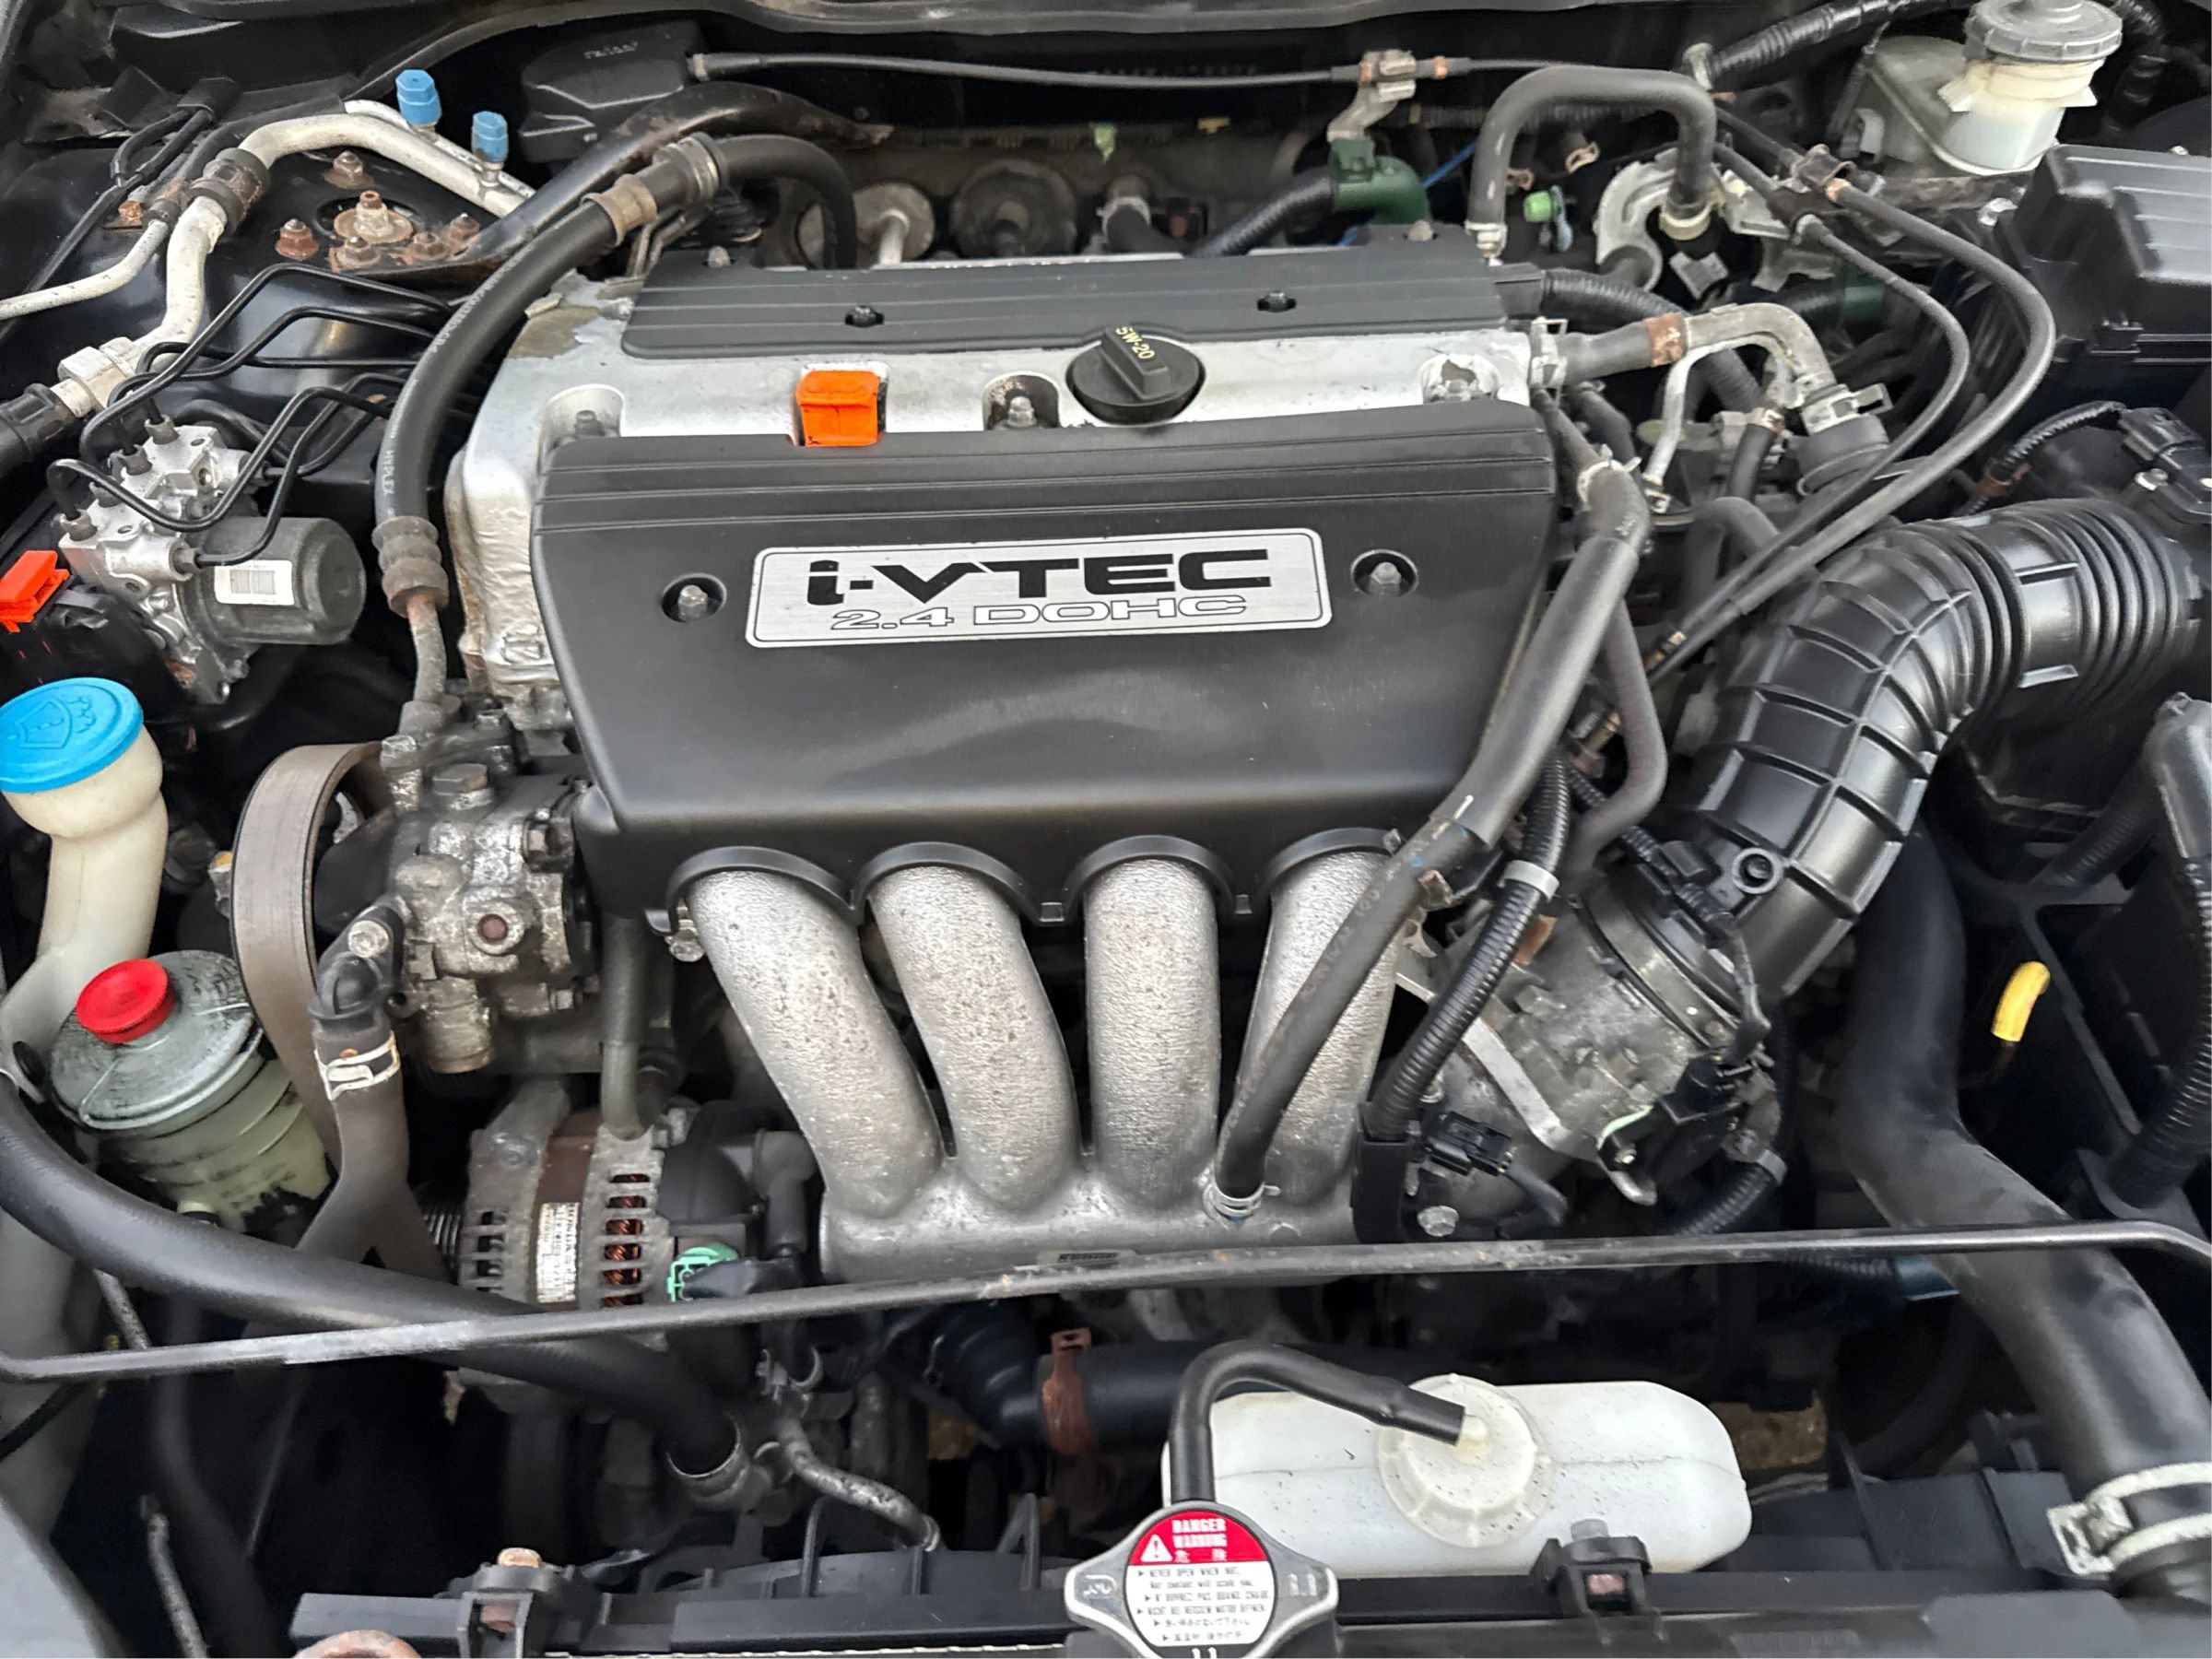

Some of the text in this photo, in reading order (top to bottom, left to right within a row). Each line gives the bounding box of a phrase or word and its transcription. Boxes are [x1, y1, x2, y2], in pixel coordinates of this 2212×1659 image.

[1115, 326, 1156, 359] 5W-20
[806, 548, 1273, 606] i-VTEC
[831, 594, 1247, 629] 2.4 DOHC
[1171, 1518, 1227, 1534] DANGER
[1172, 1534, 1228, 1548] WARNING
